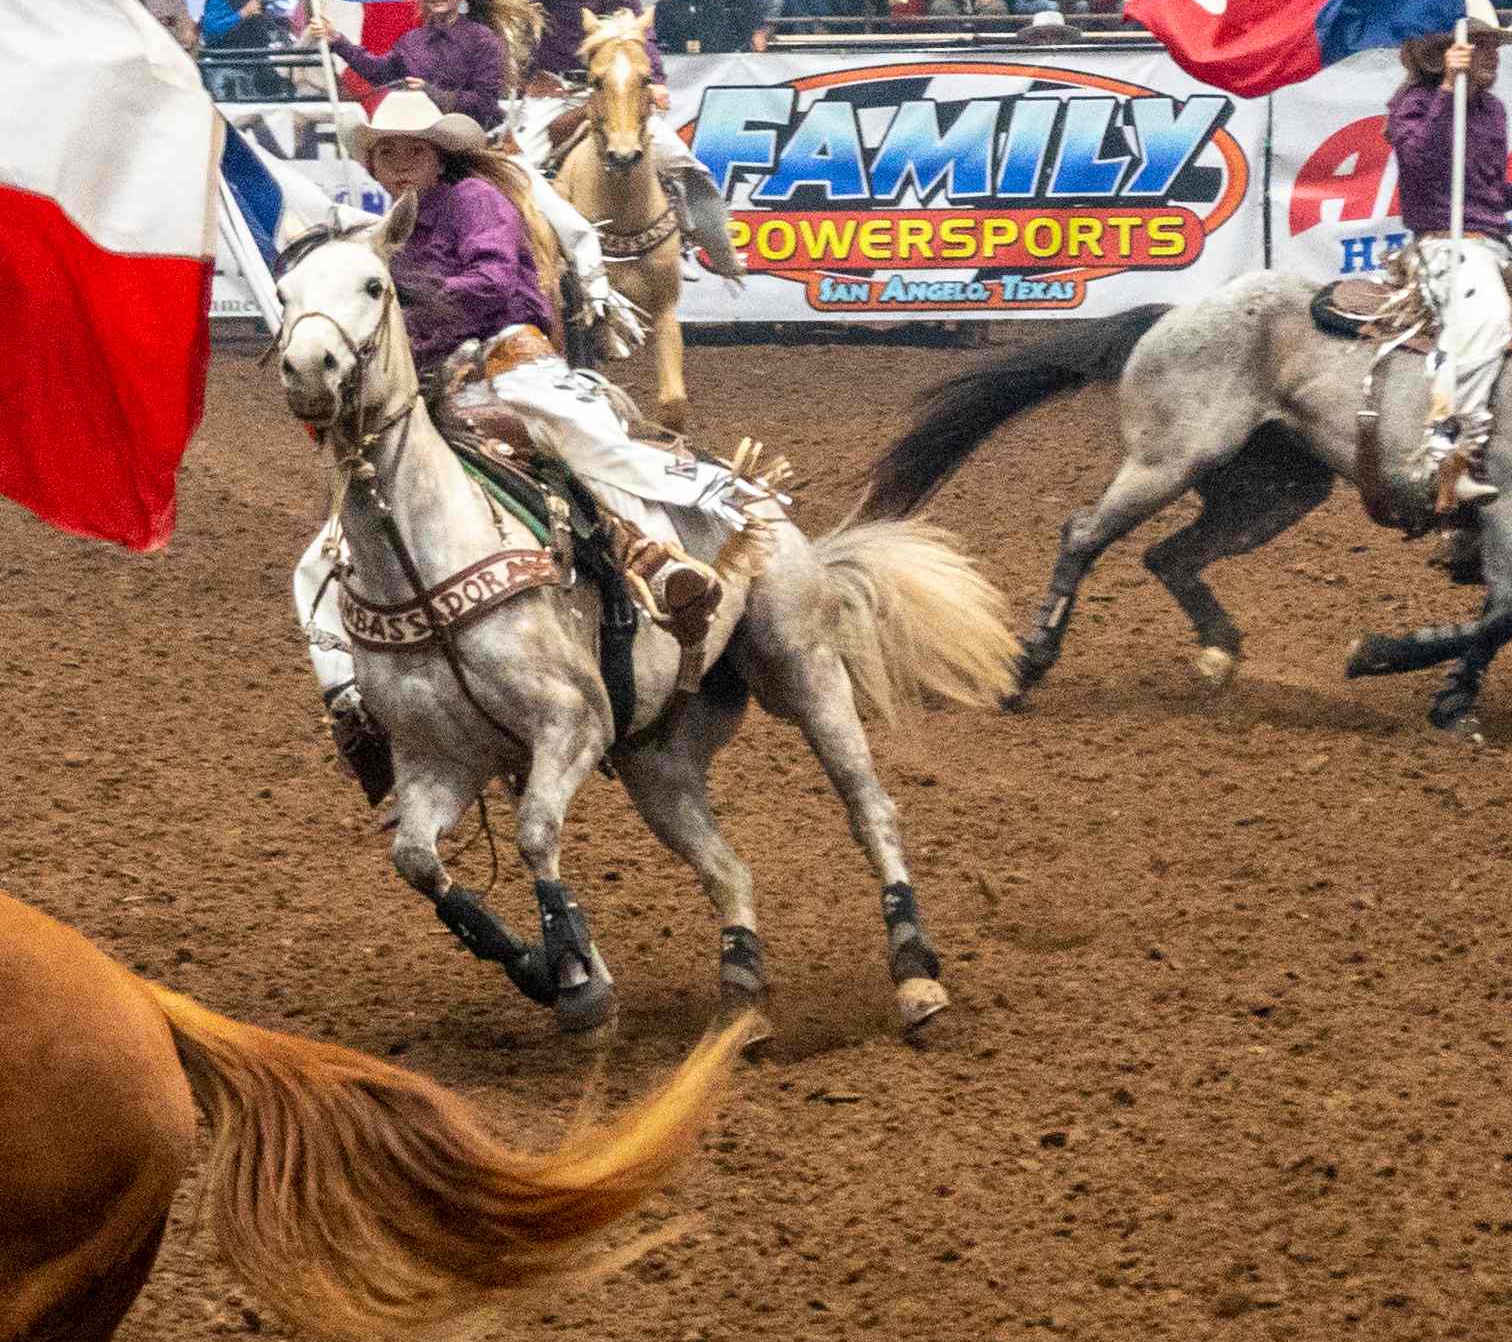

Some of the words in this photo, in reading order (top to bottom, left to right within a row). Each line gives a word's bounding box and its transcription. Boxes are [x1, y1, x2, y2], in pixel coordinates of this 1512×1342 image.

[690, 85, 1236, 209] FAMILY
[730, 214, 1189, 261] POWERSPORTS
[818, 274, 879, 303] SAN
[1001, 274, 1077, 302] TEXAS
